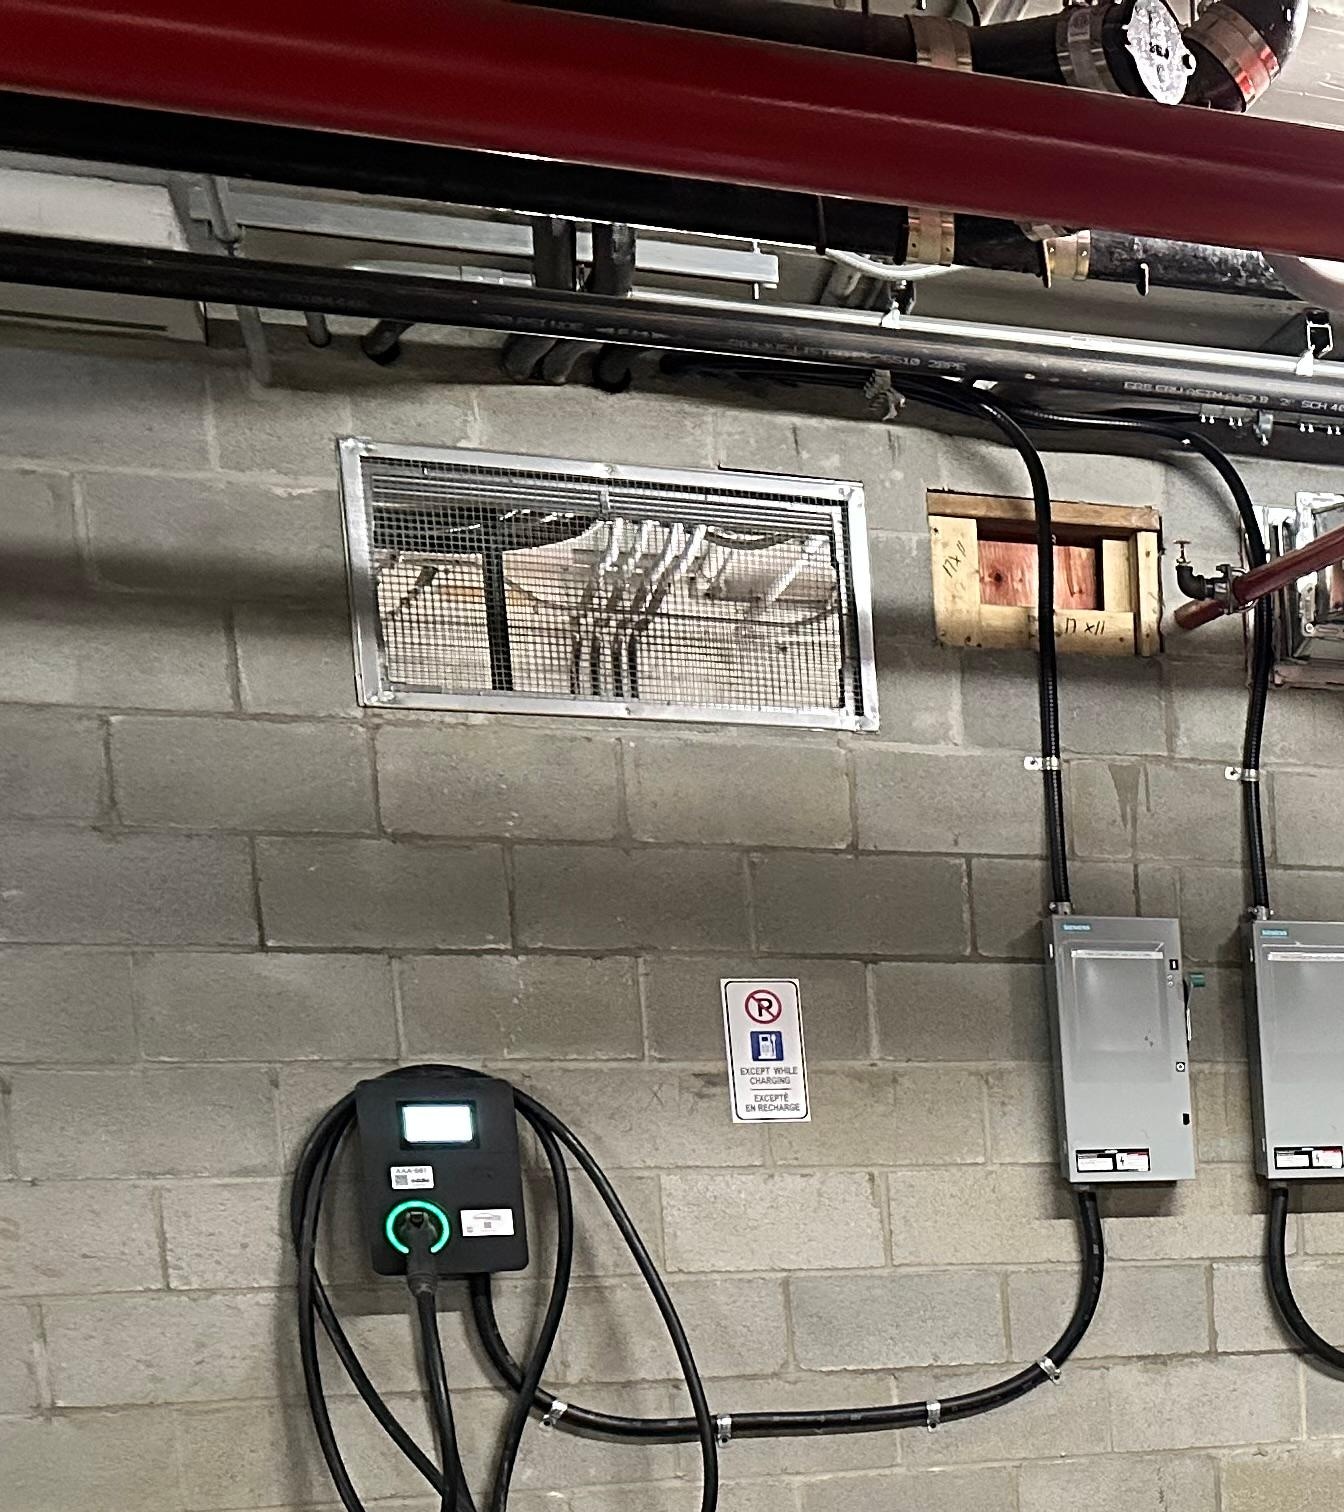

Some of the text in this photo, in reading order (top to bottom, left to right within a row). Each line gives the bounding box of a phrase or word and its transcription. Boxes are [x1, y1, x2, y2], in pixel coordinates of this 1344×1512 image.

[740, 1066, 798, 1076] EXCEPT WHILE
[750, 1076, 791, 1085] CHARGING
[745, 1103, 800, 1112] EN RECHARGE
